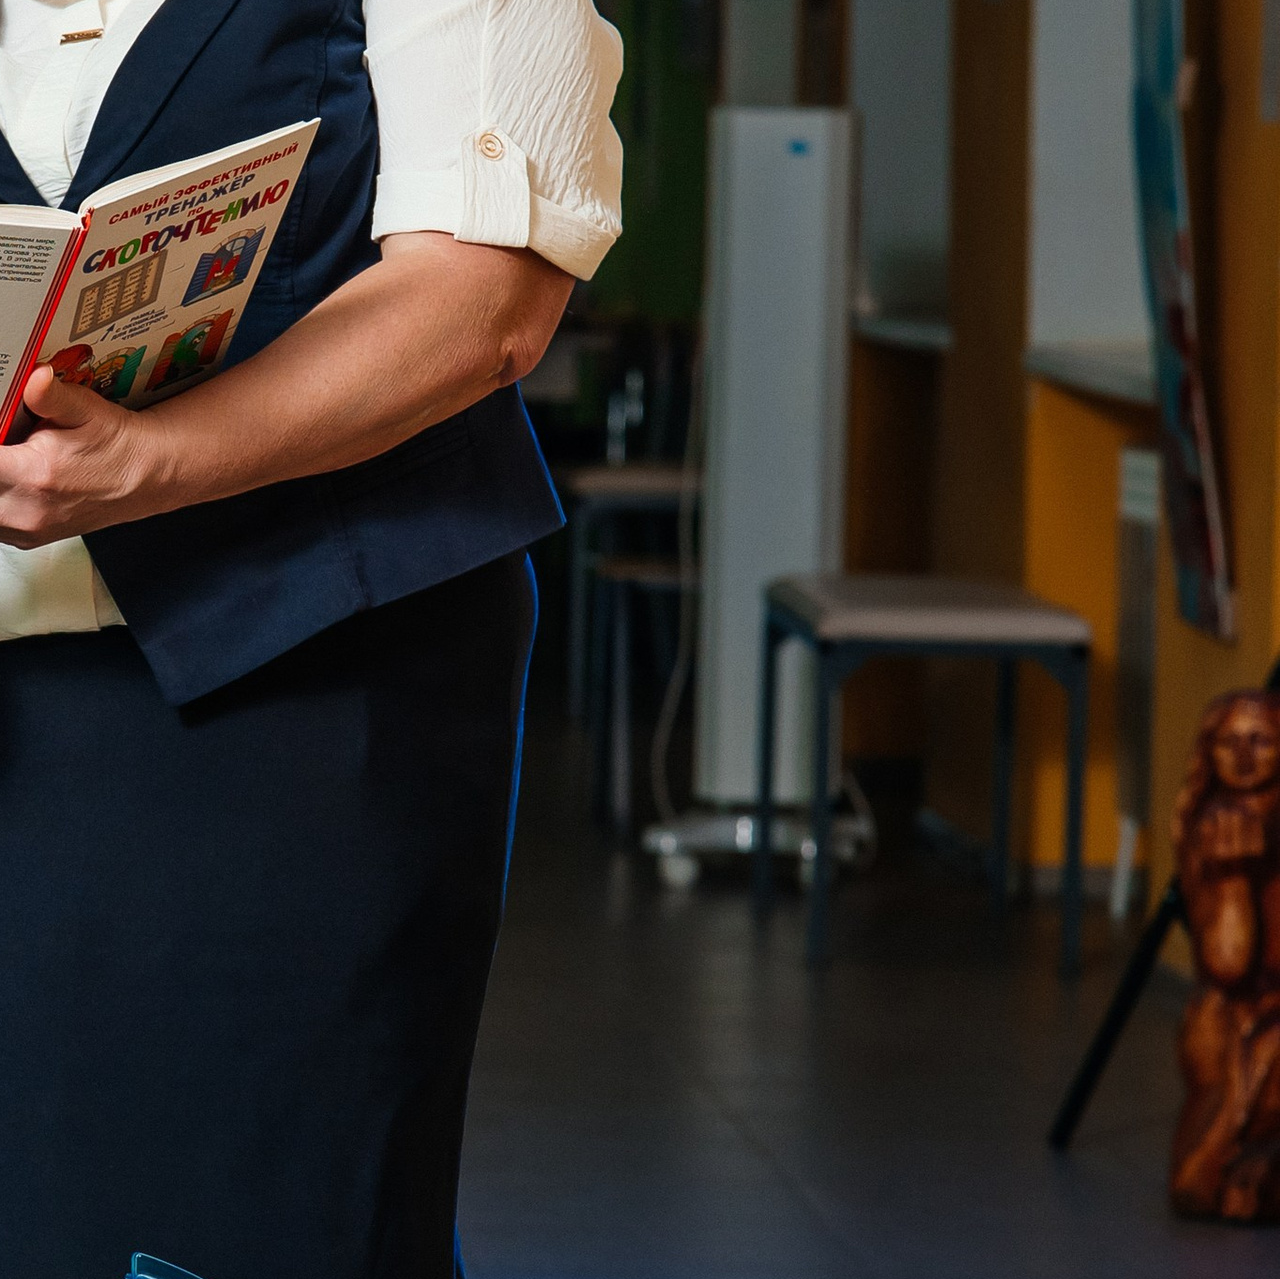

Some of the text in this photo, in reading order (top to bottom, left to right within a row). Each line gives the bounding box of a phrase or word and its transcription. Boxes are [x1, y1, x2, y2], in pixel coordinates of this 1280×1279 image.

[109, 141, 299, 225] САМЫЙ ЭФФЕКТИВНЫЙ
[144, 173, 256, 225] ТРЕНАЖЁР
[187, 205, 204, 218] ПО
[82, 179, 290, 274] СКОРОЧТЕНИЮ
